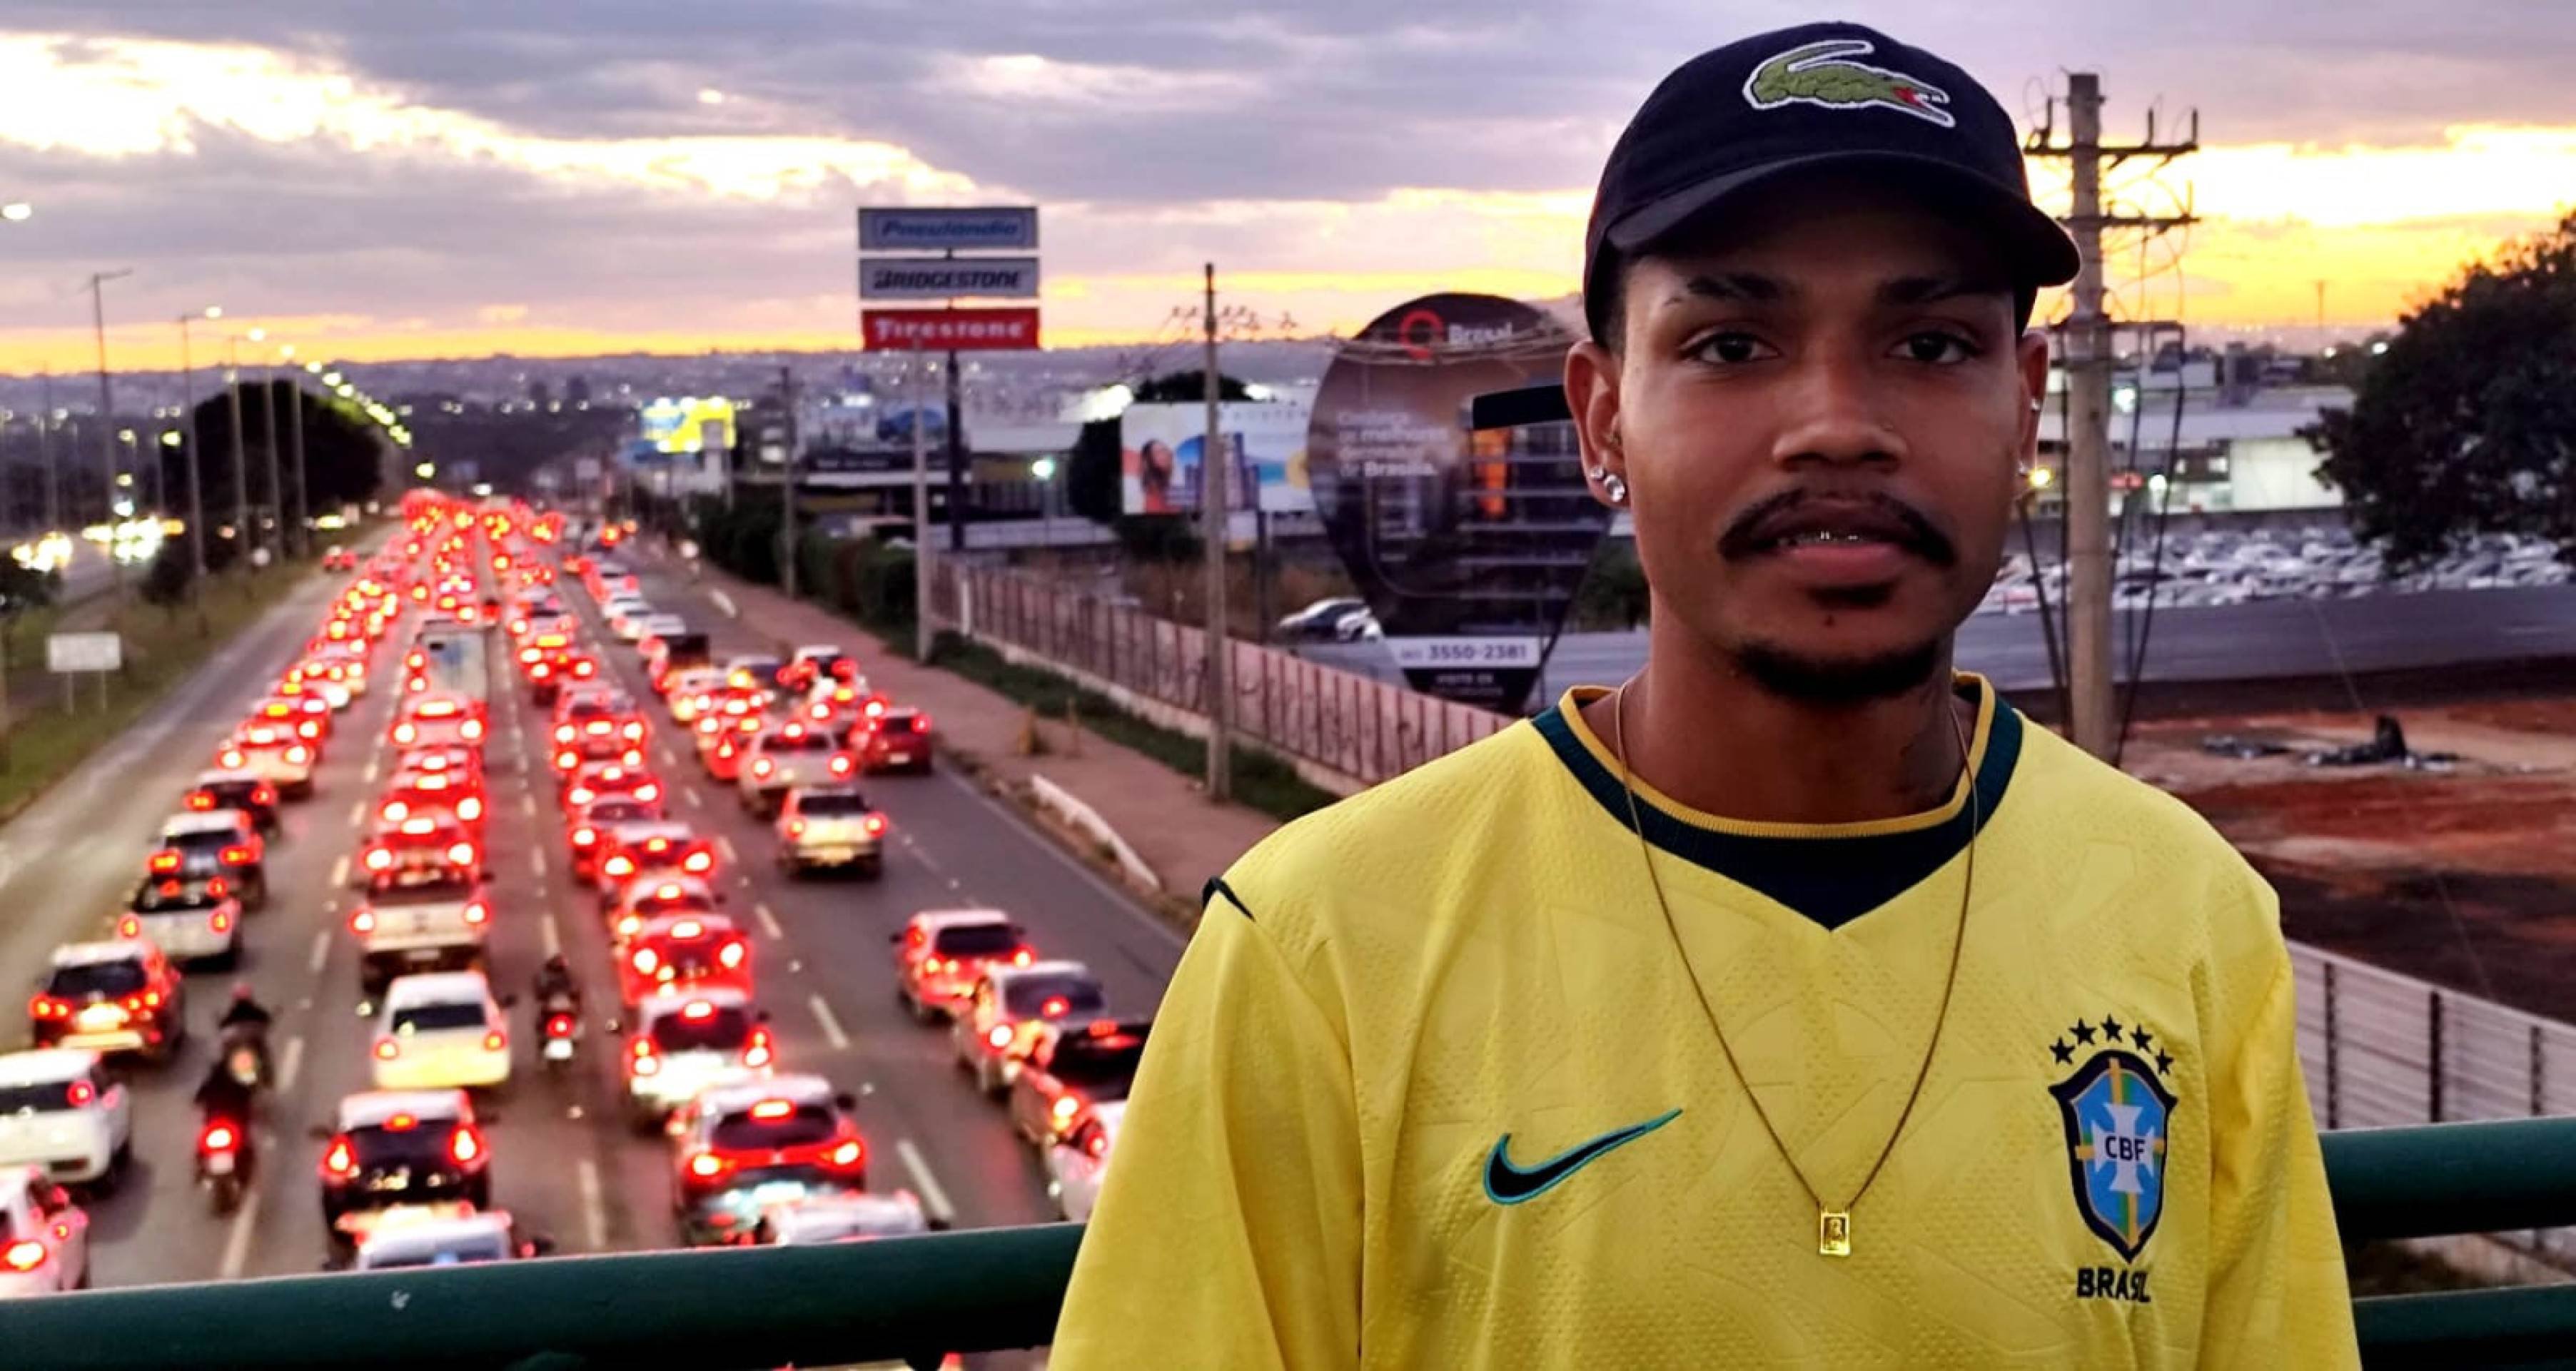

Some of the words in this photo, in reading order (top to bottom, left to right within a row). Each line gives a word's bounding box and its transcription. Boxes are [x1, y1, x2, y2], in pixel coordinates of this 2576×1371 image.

[874, 270, 1020, 290] BRIDGESTONE
[874, 319, 1024, 342] Firestone
[1429, 644, 1527, 660] 3550-2381
[2105, 1135, 2146, 1161] CBF
